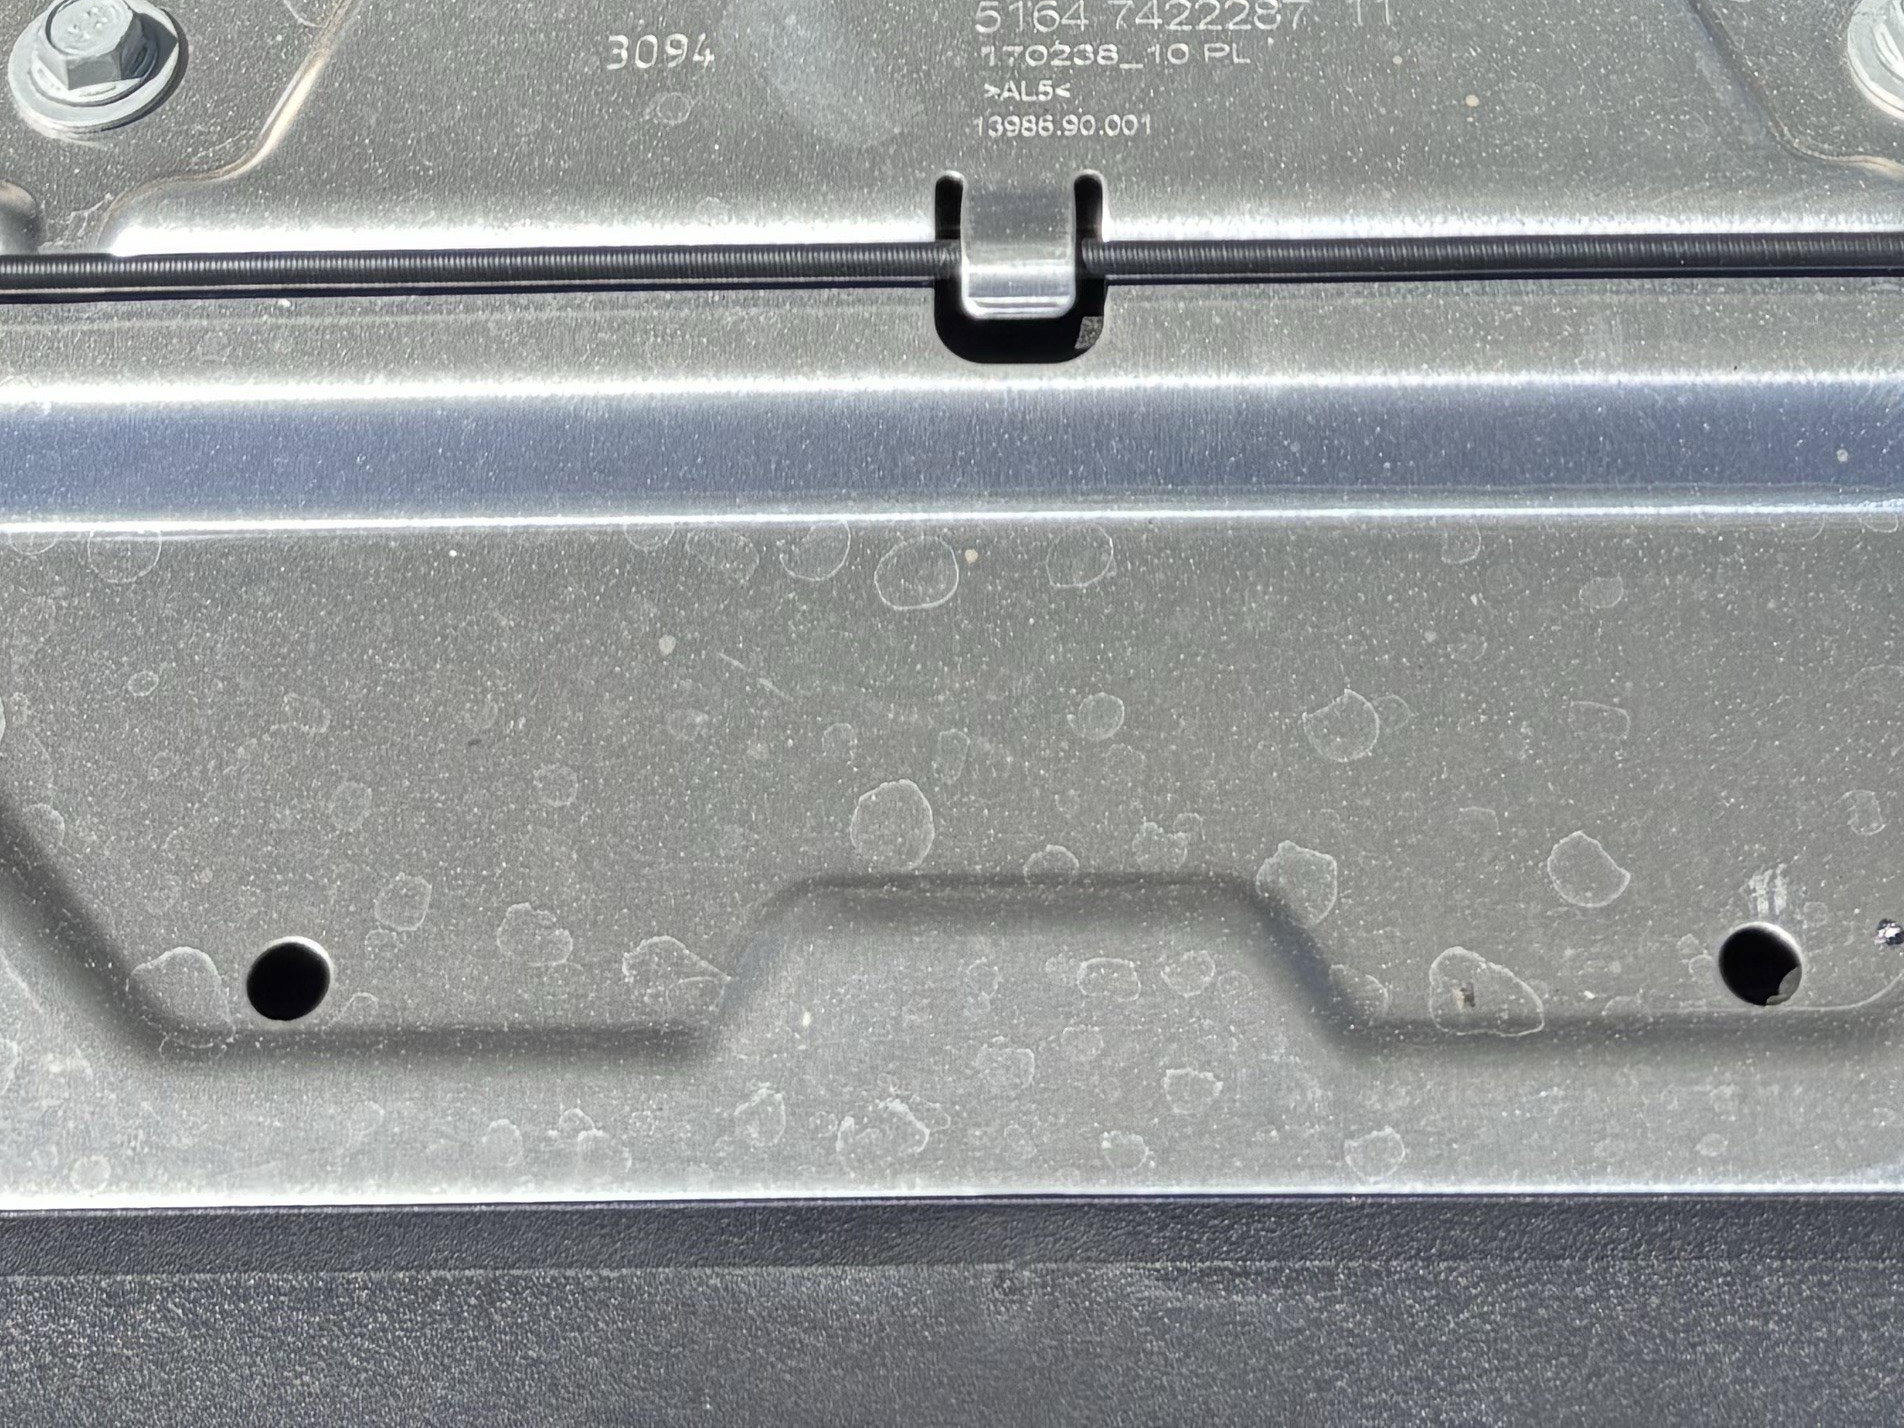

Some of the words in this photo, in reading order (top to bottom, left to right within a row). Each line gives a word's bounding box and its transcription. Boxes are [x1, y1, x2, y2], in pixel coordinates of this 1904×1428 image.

[974, 0, 1090, 34] 5164
[606, 32, 715, 72] 3094
[1203, 42, 1252, 65] PL
[972, 113, 1153, 138] 13986.90.001
